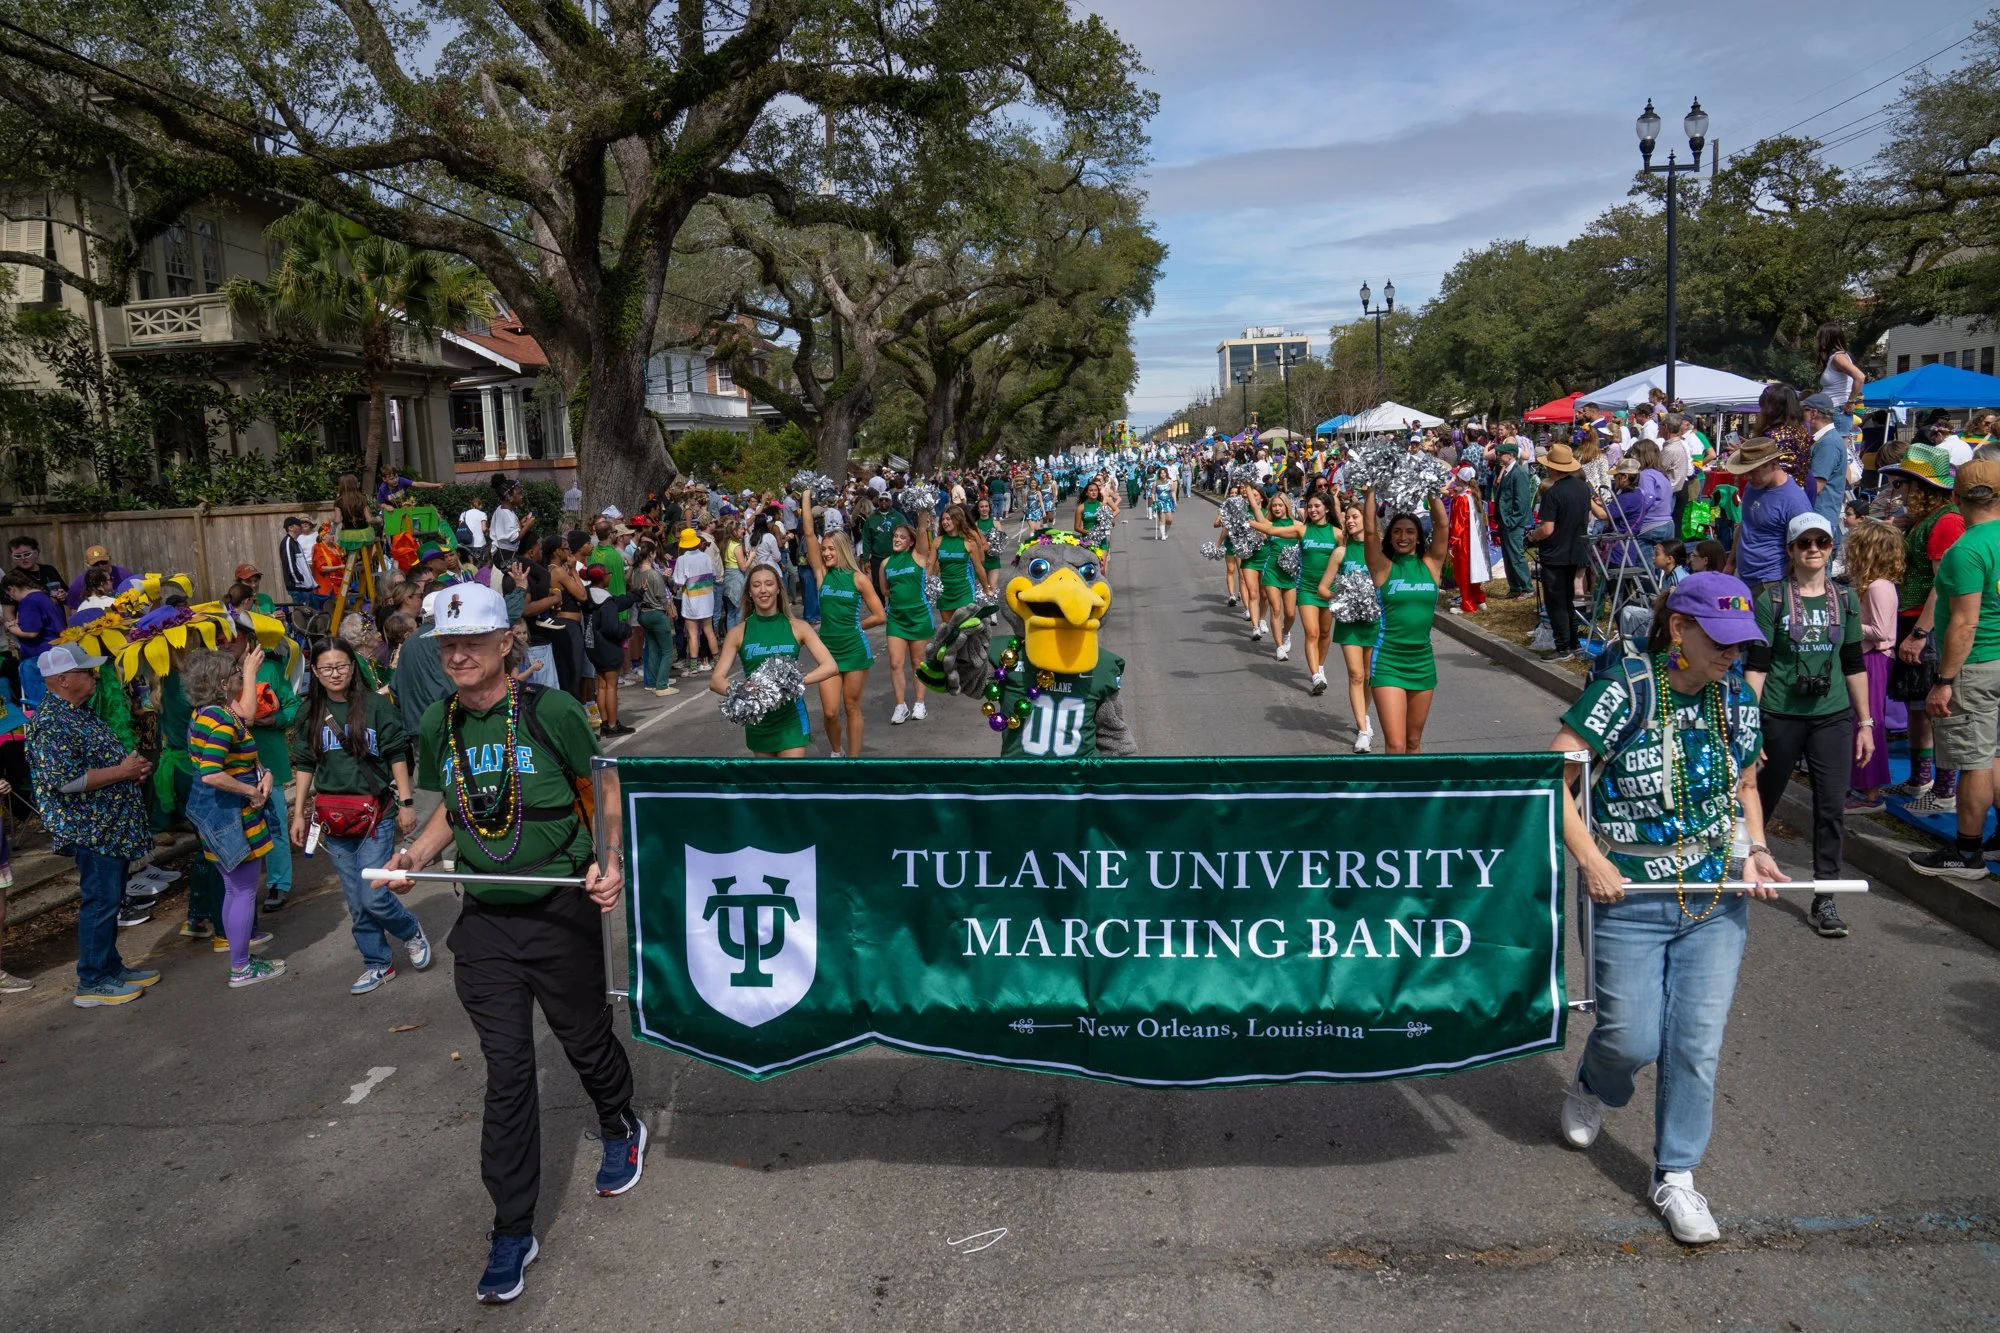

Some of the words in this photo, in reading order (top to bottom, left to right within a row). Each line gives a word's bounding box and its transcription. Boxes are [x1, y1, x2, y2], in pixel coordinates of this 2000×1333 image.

[1021, 694, 1086, 757] 00
[893, 849, 1128, 889] TULANE
[1146, 848, 1504, 889] UNIVERSITY
[1943, 860, 1966, 868] HOKA
[962, 917, 1288, 958] MARCHING
[1306, 918, 1471, 958] BAND
[1078, 1016, 1130, 1037] New
[1137, 1018, 1238, 1039] Orleans,
[1247, 1018, 1365, 1039] Louisiana
